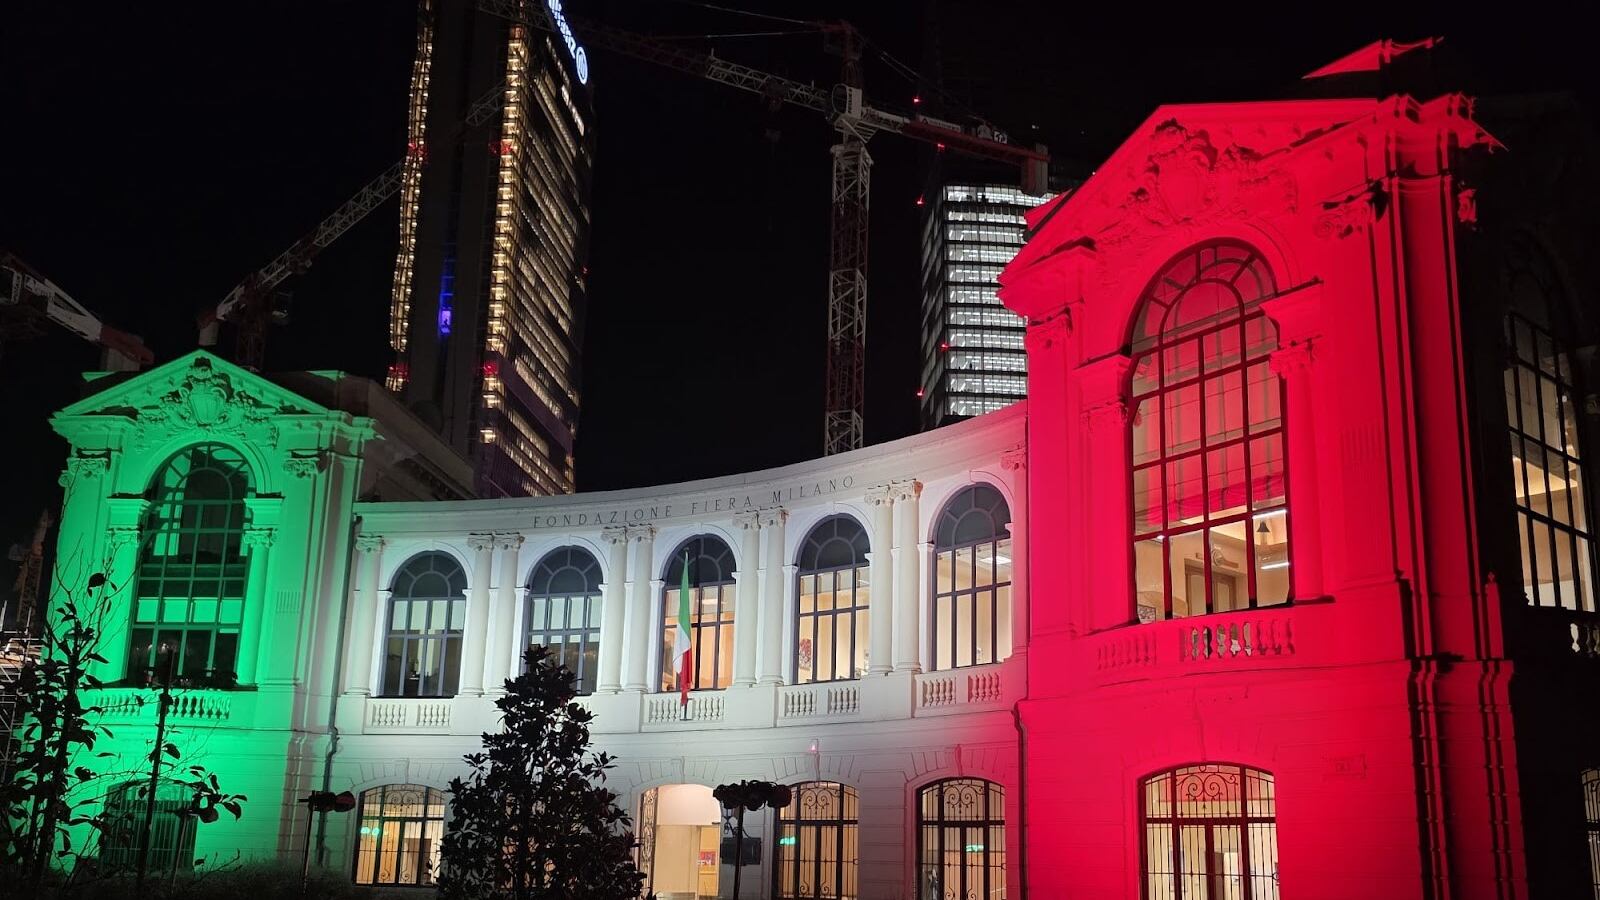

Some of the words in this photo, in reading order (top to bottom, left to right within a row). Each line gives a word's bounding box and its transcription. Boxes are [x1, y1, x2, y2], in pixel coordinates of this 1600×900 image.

[534, 505, 672, 528] FONDAZIONE
[691, 495, 752, 516] FIERA
[772, 475, 854, 503] MILANO
